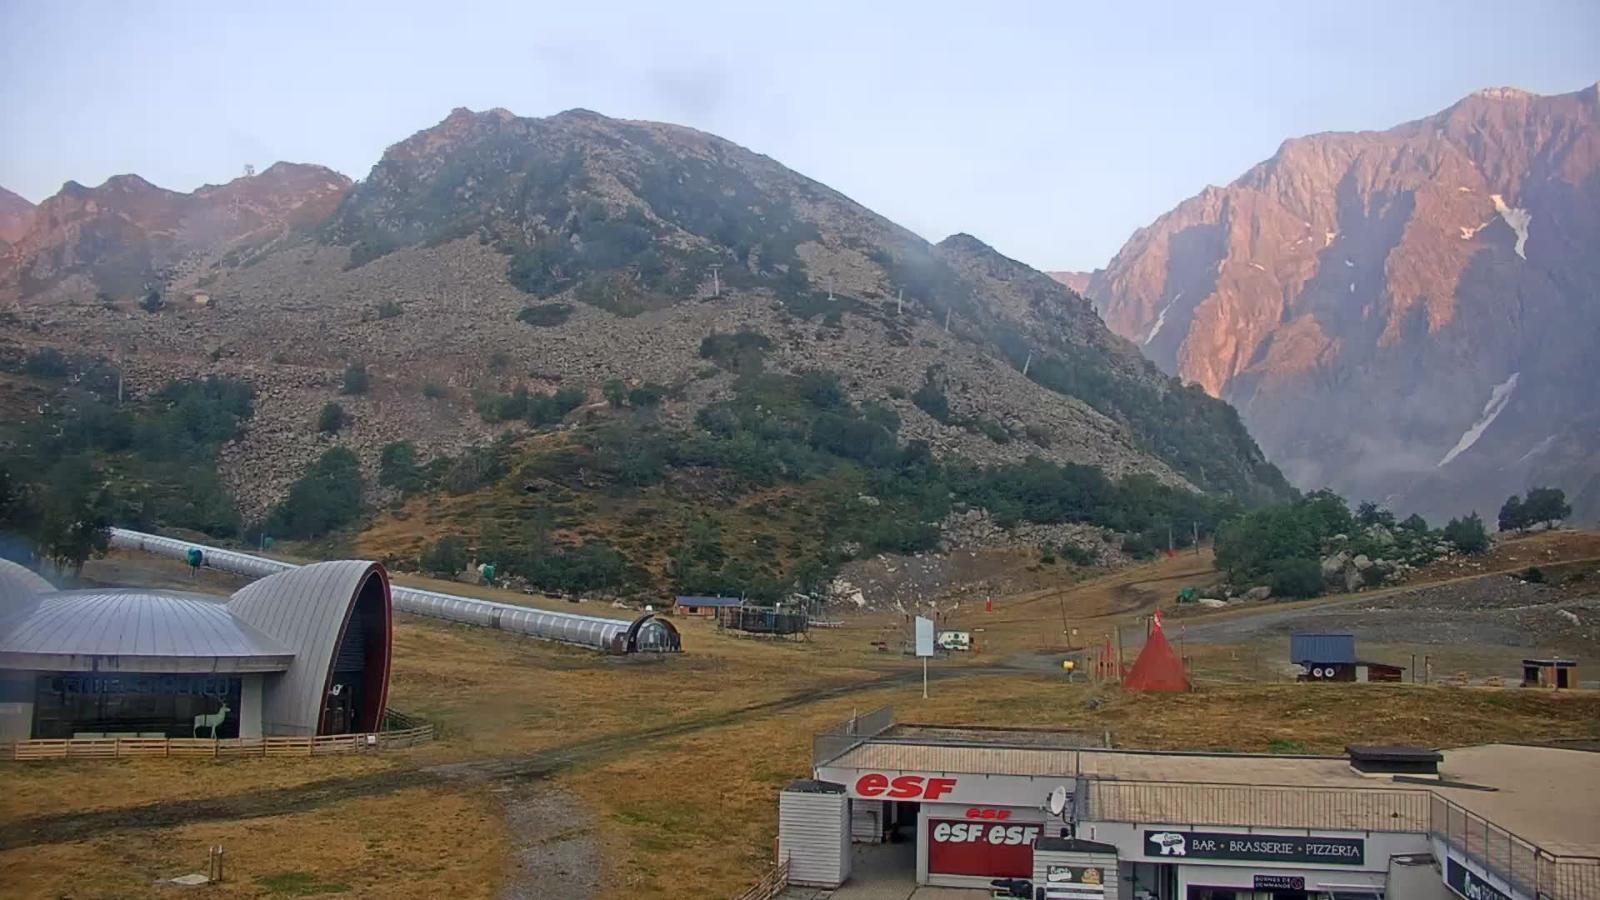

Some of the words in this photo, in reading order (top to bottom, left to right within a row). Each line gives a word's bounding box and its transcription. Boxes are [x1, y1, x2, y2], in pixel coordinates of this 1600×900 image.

[1192, 839, 1216, 850] BAR
[1229, 841, 1293, 854] BRASSERIE
[1306, 844, 1360, 857] PIZZERIA
